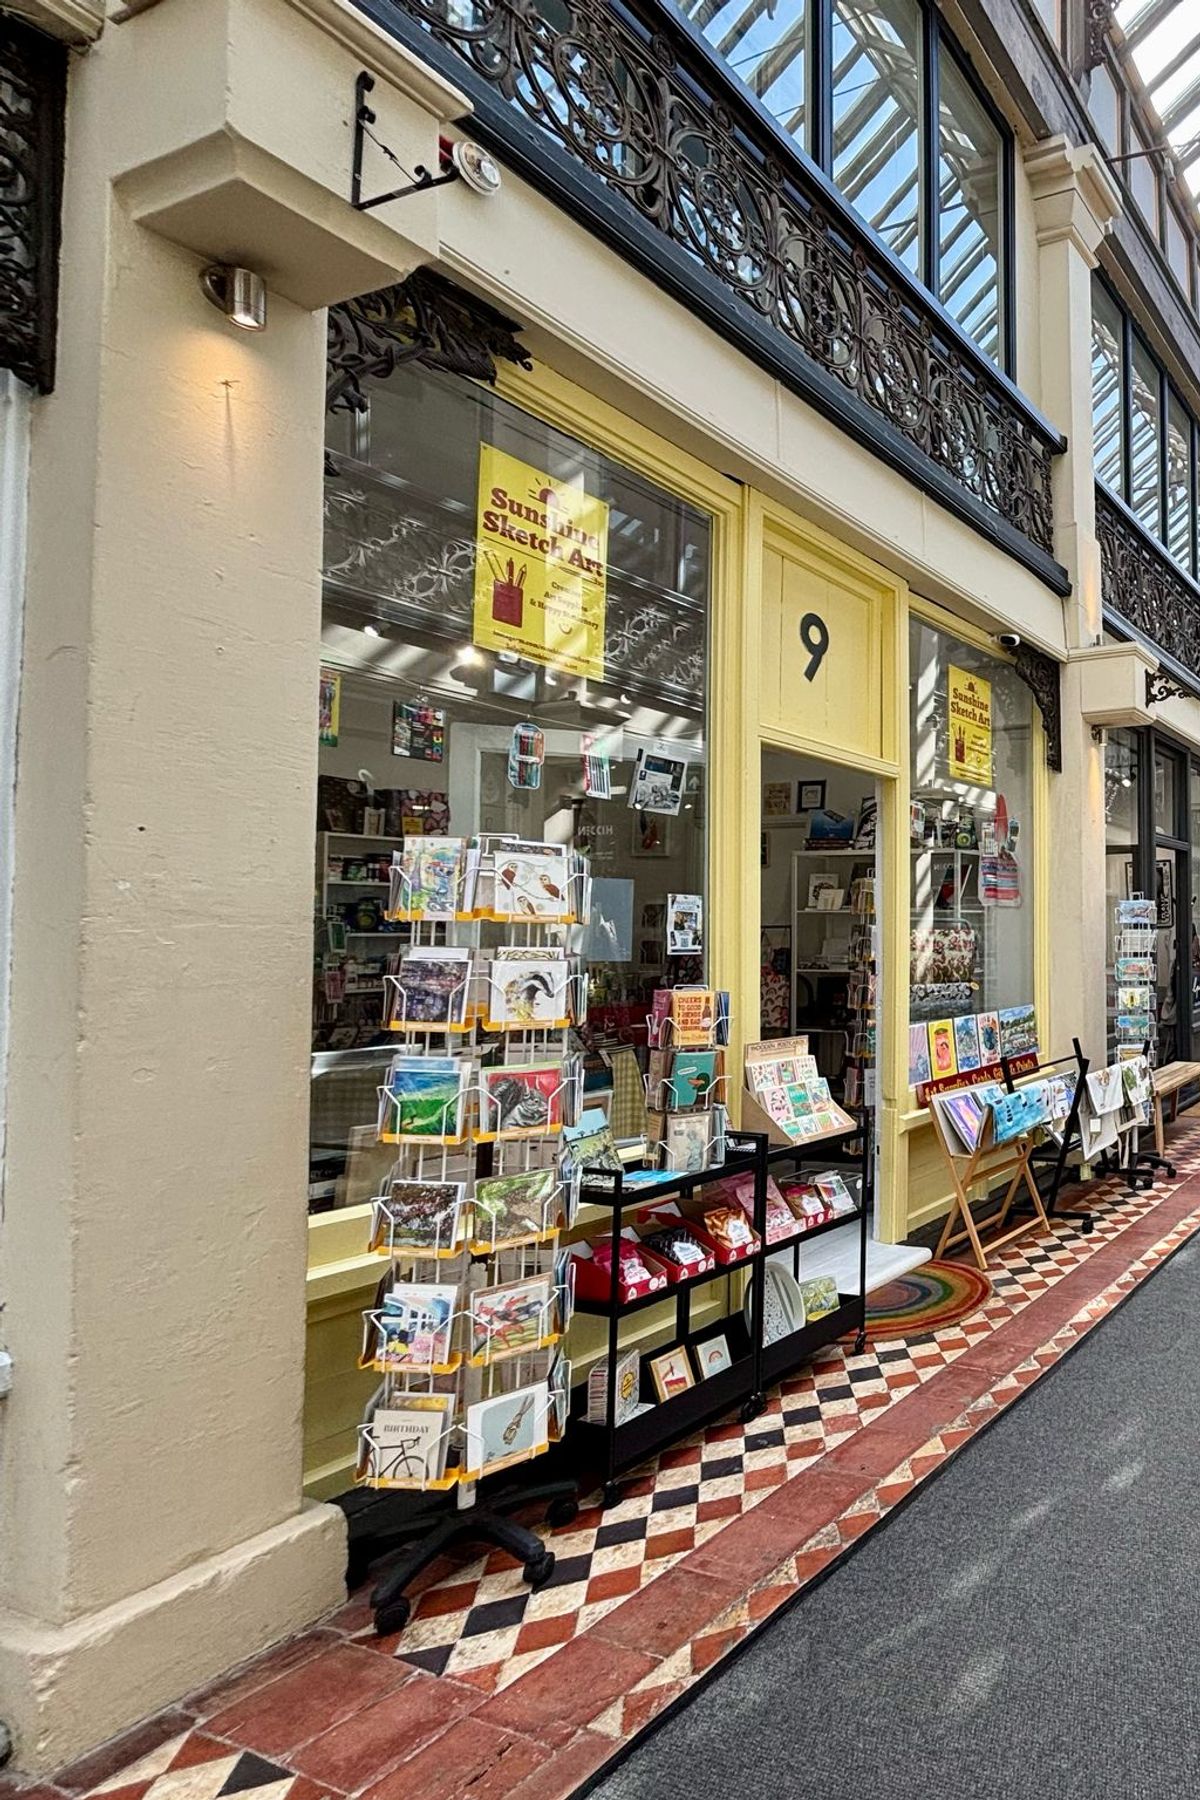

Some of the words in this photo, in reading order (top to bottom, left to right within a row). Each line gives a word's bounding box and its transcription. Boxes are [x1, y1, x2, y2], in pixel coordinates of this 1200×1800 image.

[491, 487, 600, 550] Sunshine
[482, 510, 565, 561] Sketch
[567, 548, 604, 578] Art
[799, 611, 830, 682] 9
[950, 702, 978, 722] Sketch
[978, 713, 990, 726] Art
[953, 687, 989, 712] Sunshine
[383, 1424, 430, 1434] BIRTHDAY
